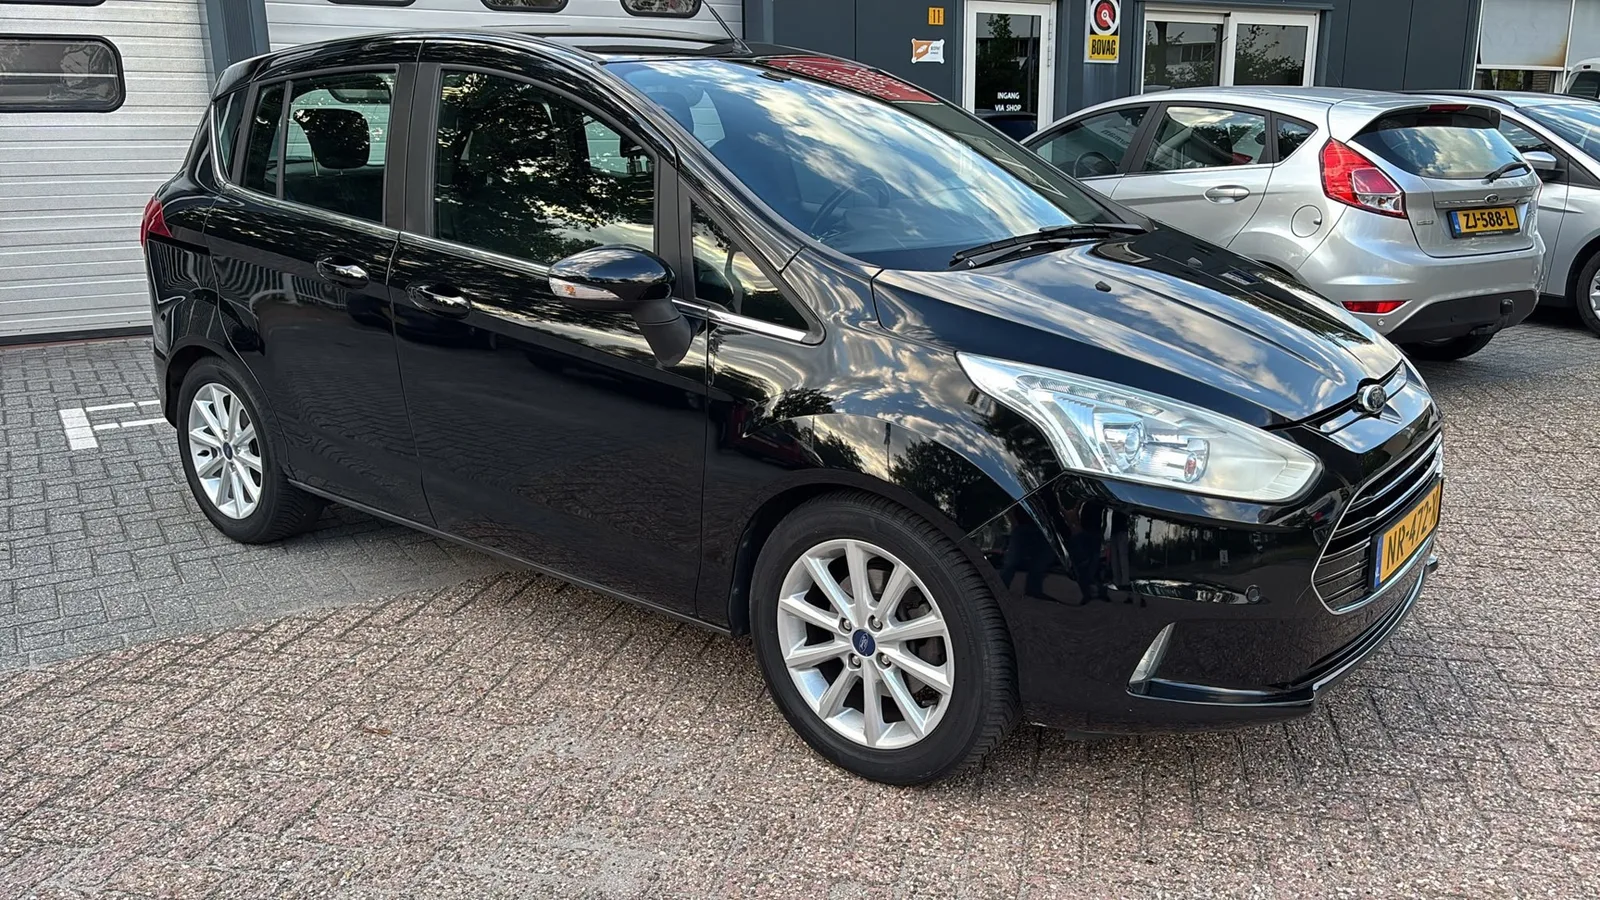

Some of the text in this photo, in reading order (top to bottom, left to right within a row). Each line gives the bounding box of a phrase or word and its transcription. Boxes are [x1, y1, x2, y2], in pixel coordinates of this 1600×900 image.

[1091, 39, 1116, 56] BOVAG
[997, 92, 1020, 100] INGANG
[994, 104, 1022, 112] VIA SHOP
[1462, 210, 1515, 230] ZJ-588-L
